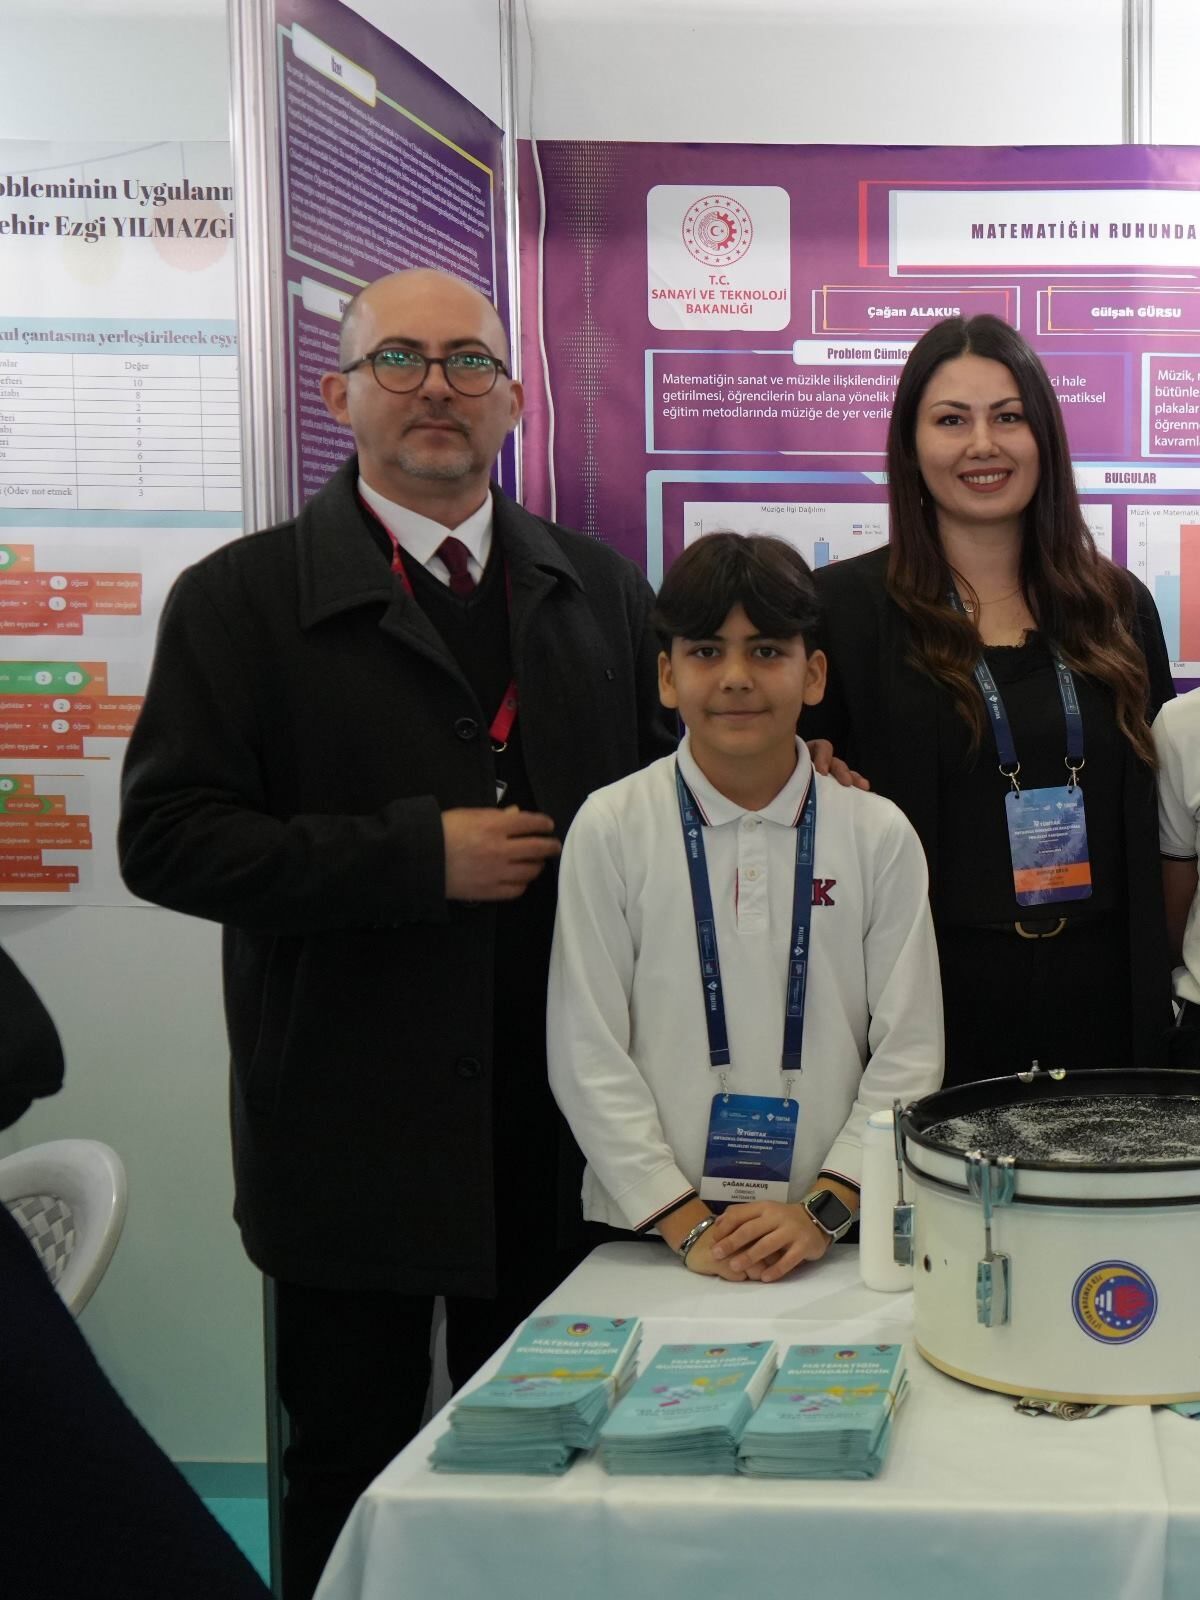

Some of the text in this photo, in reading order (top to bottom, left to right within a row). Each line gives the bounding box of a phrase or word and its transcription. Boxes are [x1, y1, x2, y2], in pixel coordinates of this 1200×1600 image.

[55, 216, 106, 243] Ezgi
[971, 220, 1099, 239] MATEMATİĞİN
[708, 275, 730, 285] T.C.
[651, 288, 787, 301] SANAYİ VE TEKNOLOJİ
[686, 302, 753, 314] BAKANLIĞI
[867, 306, 907, 319] Çağan
[1091, 305, 1182, 320] Gülşah GÜRSU
[21, 330, 95, 344] çantasına
[98, 330, 207, 346] yerleştirilecek
[827, 347, 911, 360] Problem Cümle
[124, 362, 149, 371] Değer
[662, 373, 734, 387] Matematiğin
[737, 375, 767, 384] sanat
[770, 376, 783, 384] ve
[786, 374, 830, 385] müzikle
[1062, 375, 1087, 387] hale
[1157, 369, 1194, 382] Müzik,
[133, 379, 143, 387] 10
[662, 389, 889, 404] getirilmesi, öğrencilerin bu alana yönelik
[662, 406, 699, 419] eğitim
[702, 406, 777, 417] metodlarında
[780, 407, 822, 420] müziğe
[825, 406, 839, 418] de
[842, 409, 860, 420] yer
[136, 440, 142, 448] 9
[137, 452, 143, 460] 6
[1104, 472, 1157, 484] BULGULAR
[811, 878, 837, 906] K
